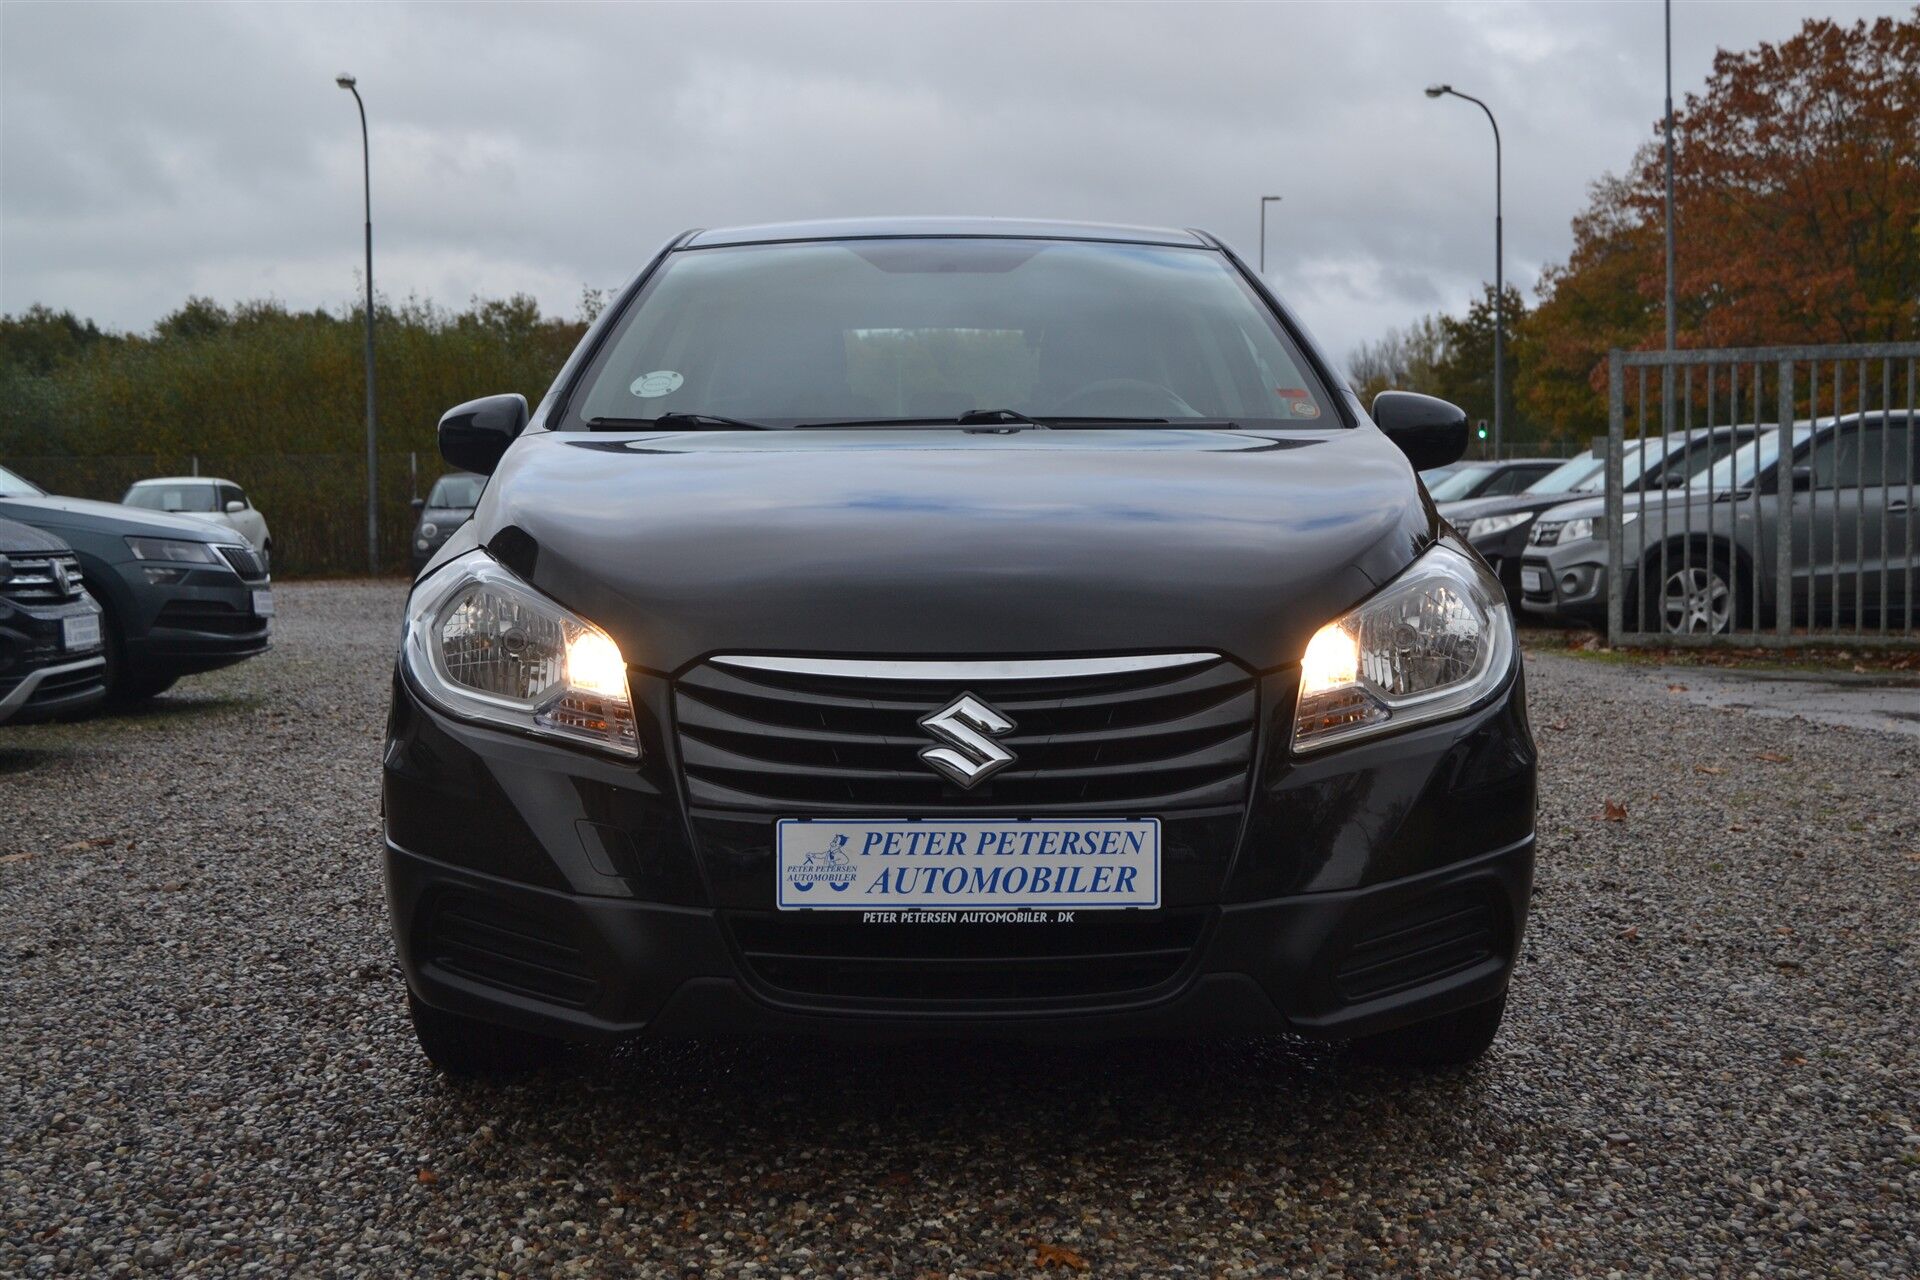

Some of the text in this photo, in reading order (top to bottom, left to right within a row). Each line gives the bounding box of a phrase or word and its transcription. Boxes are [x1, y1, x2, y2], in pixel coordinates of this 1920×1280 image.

[861, 831, 1147, 856] PETER PETERSEN
[866, 866, 1138, 894] AUTOMOBILER
[863, 912, 898, 923] PETER
[900, 912, 957, 923] PETERSEN
[960, 912, 1048, 923] AUTOMOBILER
[1057, 912, 1075, 923] DK
